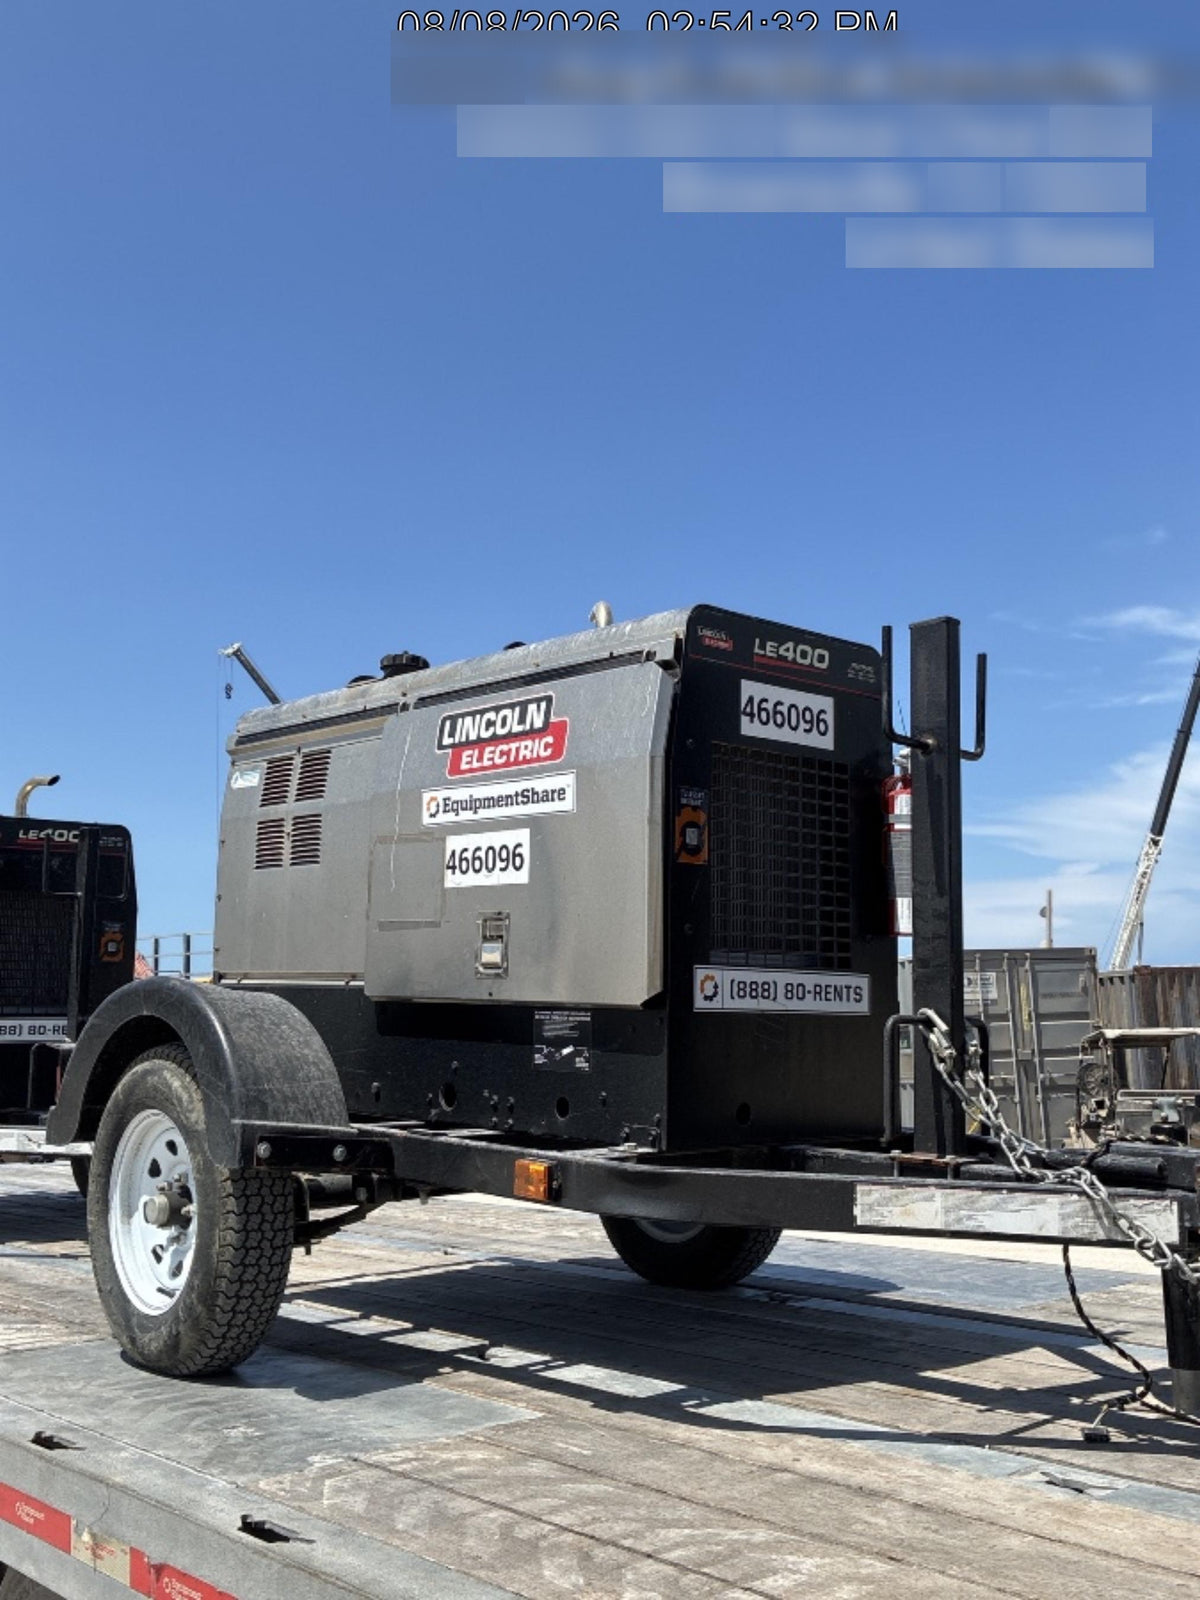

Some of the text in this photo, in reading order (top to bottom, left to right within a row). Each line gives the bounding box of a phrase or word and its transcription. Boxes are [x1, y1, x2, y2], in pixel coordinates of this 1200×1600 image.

[753, 638, 830, 669] LE400
[441, 701, 547, 746] LINCOLN
[741, 695, 829, 737] 466096
[459, 735, 554, 771] ELECTRIC
[442, 786, 566, 816] EquipmentShare
[445, 842, 525, 876] 466096
[729, 978, 863, 1003] (888) 80-RENTS
[27, 1024, 68, 1036] 80-RE
